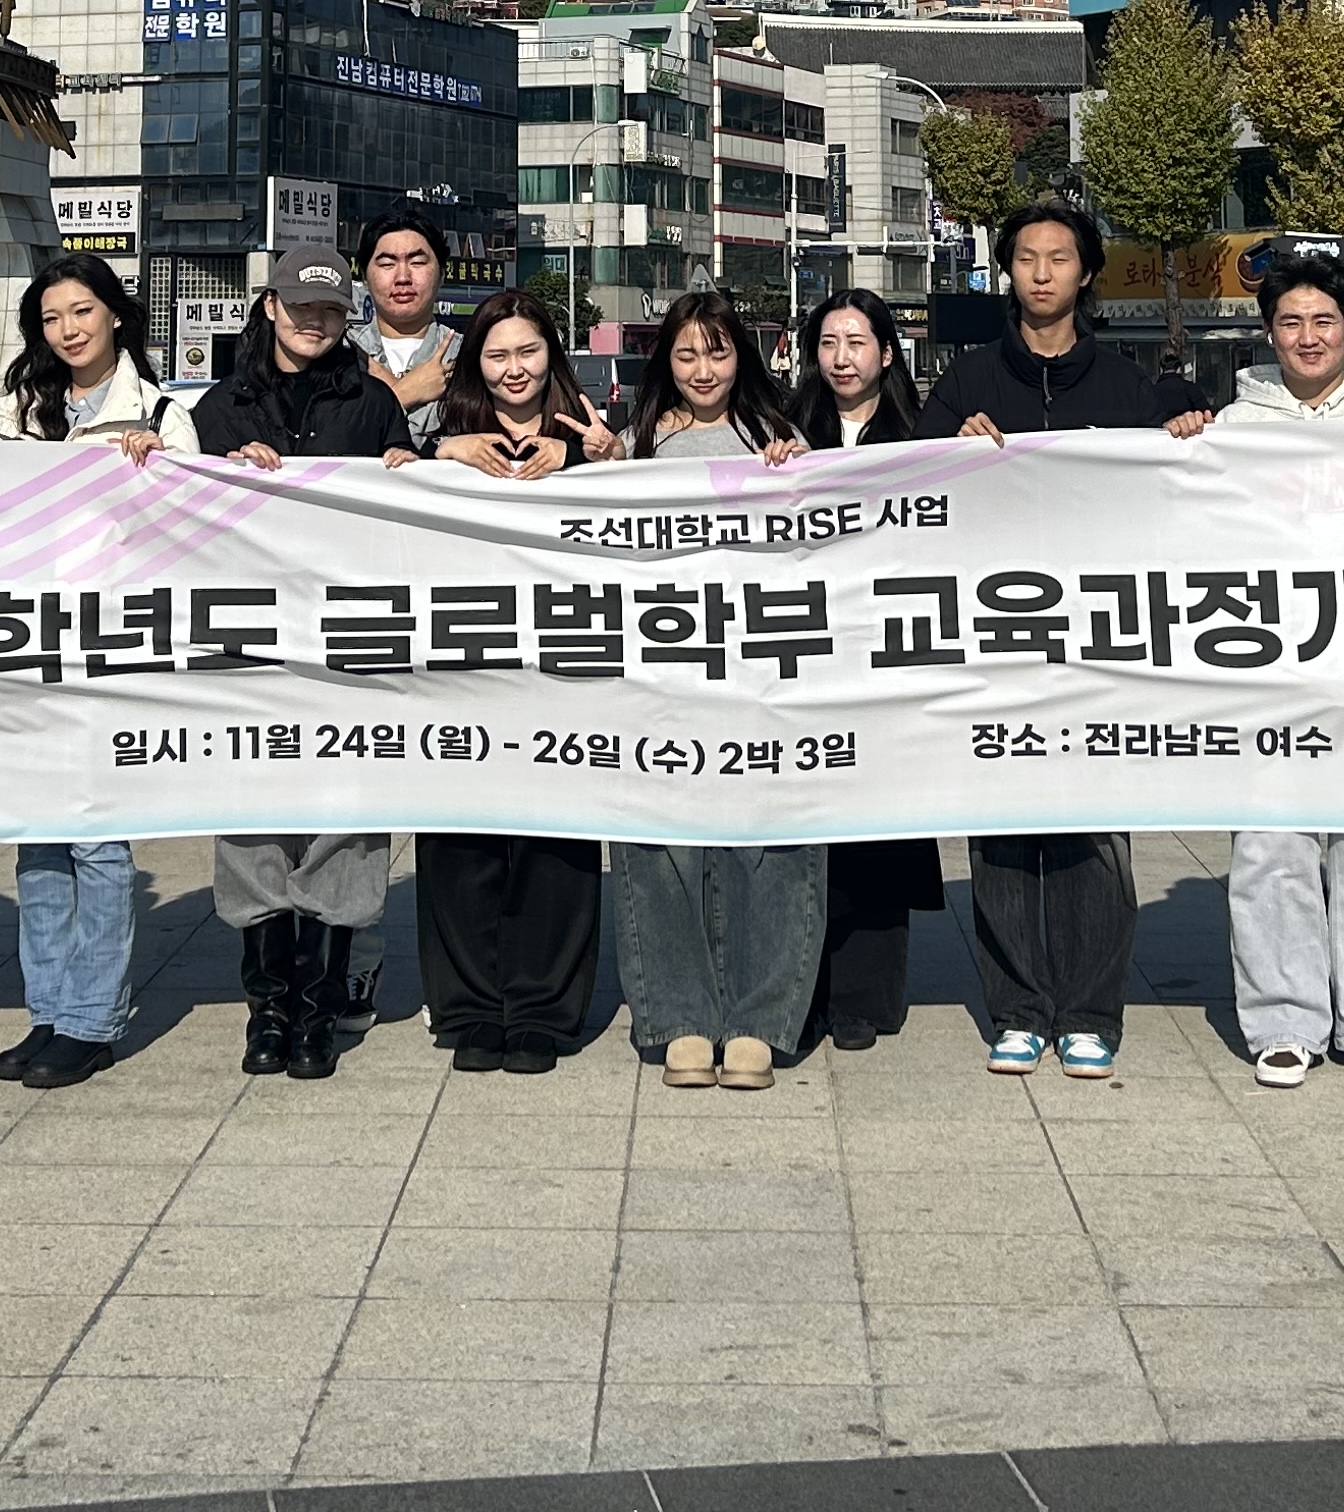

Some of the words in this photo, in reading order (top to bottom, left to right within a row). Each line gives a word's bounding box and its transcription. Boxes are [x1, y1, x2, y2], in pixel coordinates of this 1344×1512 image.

[58, 200, 133, 220] 메밀식당
[279, 188, 332, 218] 메밀식당
[186, 303, 245, 322] 메밀식
[560, 514, 751, 550] 조선대학교
[766, 502, 862, 543] RISE
[876, 494, 948, 528] 사업
[320, 581, 832, 680] 글로벌학부
[112, 727, 187, 767] 일시
[226, 723, 301, 759] 11월
[315, 723, 405, 759] 24일
[419, 723, 490, 761] (월)
[503, 741, 520, 750] -
[532, 729, 621, 769] 26일
[635, 736, 706, 775] (수)
[718, 739, 783, 775] 2박
[795, 731, 857, 771] 3일
[971, 723, 1047, 759] 장소
[1085, 722, 1240, 757] 전라남도
[1256, 725, 1333, 758] 여수
